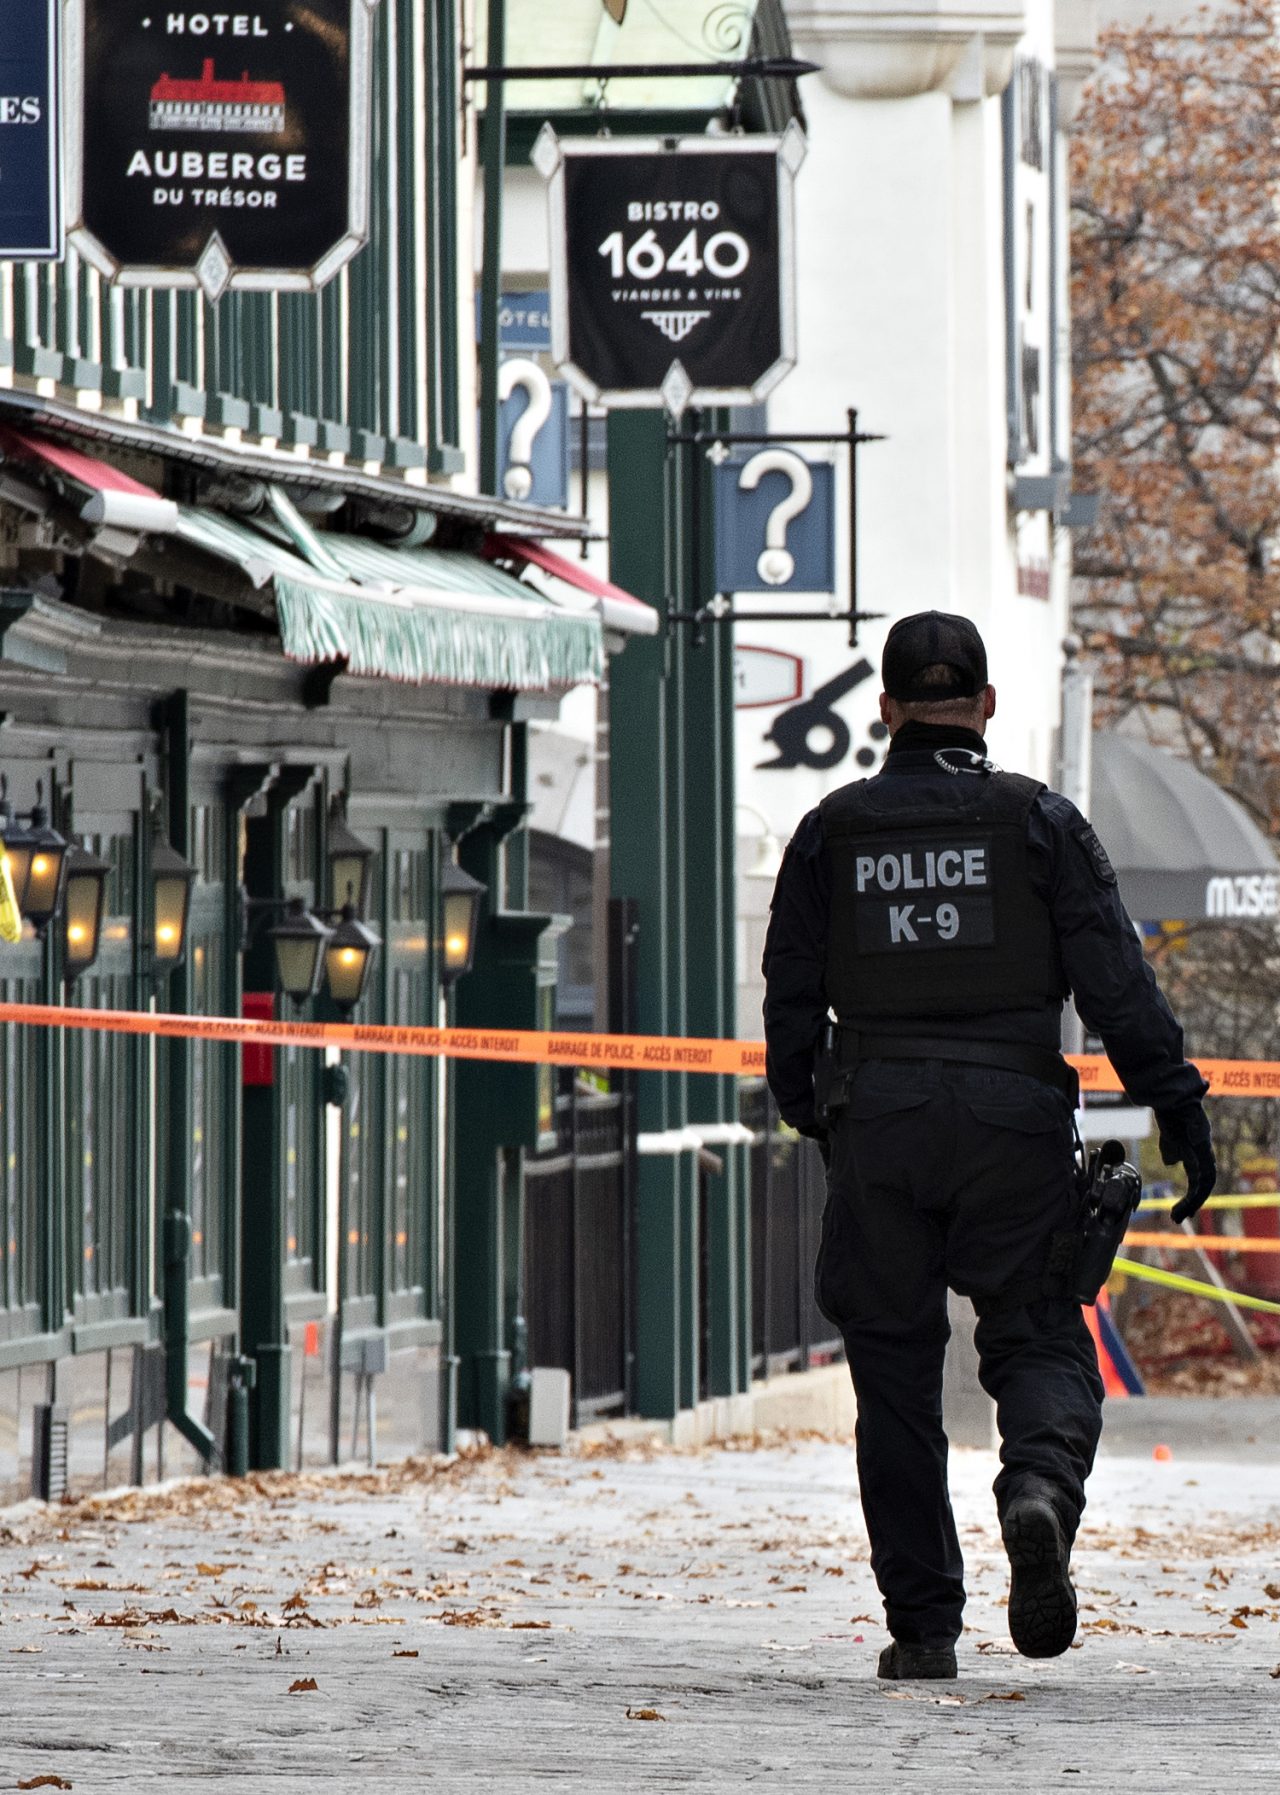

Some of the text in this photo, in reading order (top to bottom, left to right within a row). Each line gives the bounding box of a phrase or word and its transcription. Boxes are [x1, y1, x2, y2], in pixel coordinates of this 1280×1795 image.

[167, 14, 268, 36] HOTEL
[126, 150, 306, 181] AUBERGE
[153, 187, 277, 207] DU TRÉSOR
[627, 201, 720, 221] BISTRO
[598, 228, 750, 279] 1640
[498, 307, 550, 328] ÔTEL
[856, 849, 987, 892] POLICE
[889, 903, 960, 943] K-9
[548, 1040, 588, 1057] BARRAGE
[591, 1041, 602, 1058] DE
[605, 1043, 634, 1060] POLICE
[674, 1047, 712, 1064] INTERDIT
[741, 1050, 765, 1067] BARR
